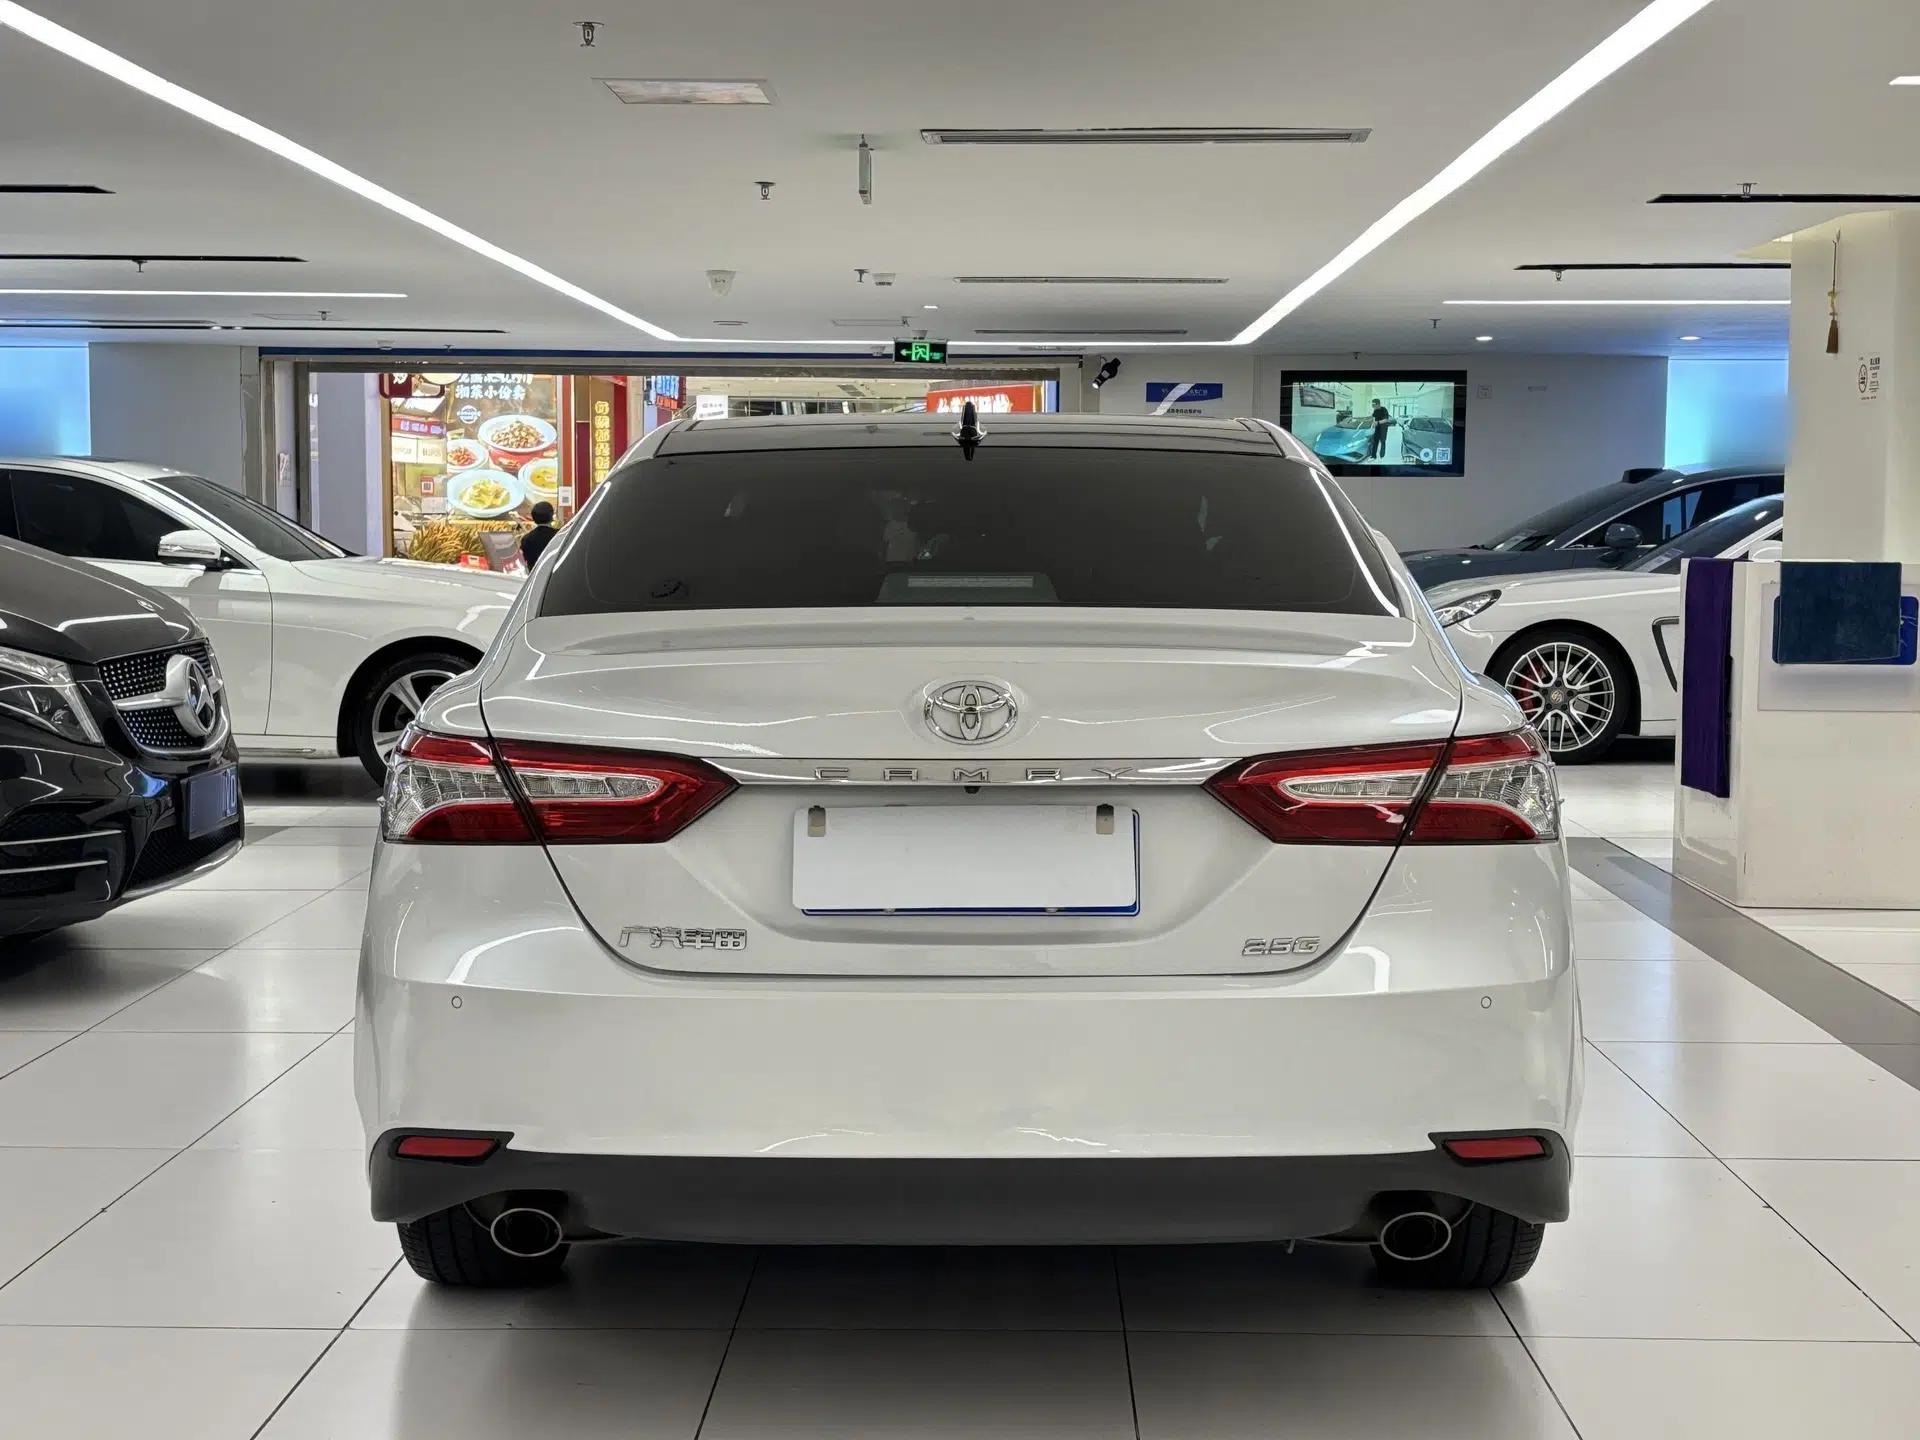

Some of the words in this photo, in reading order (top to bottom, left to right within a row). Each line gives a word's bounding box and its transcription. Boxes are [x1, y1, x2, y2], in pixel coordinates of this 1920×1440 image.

[814, 767, 1134, 781] CAMRY
[619, 926, 747, 950] 广汽丰田
[1241, 936, 1320, 956] 2.5G
